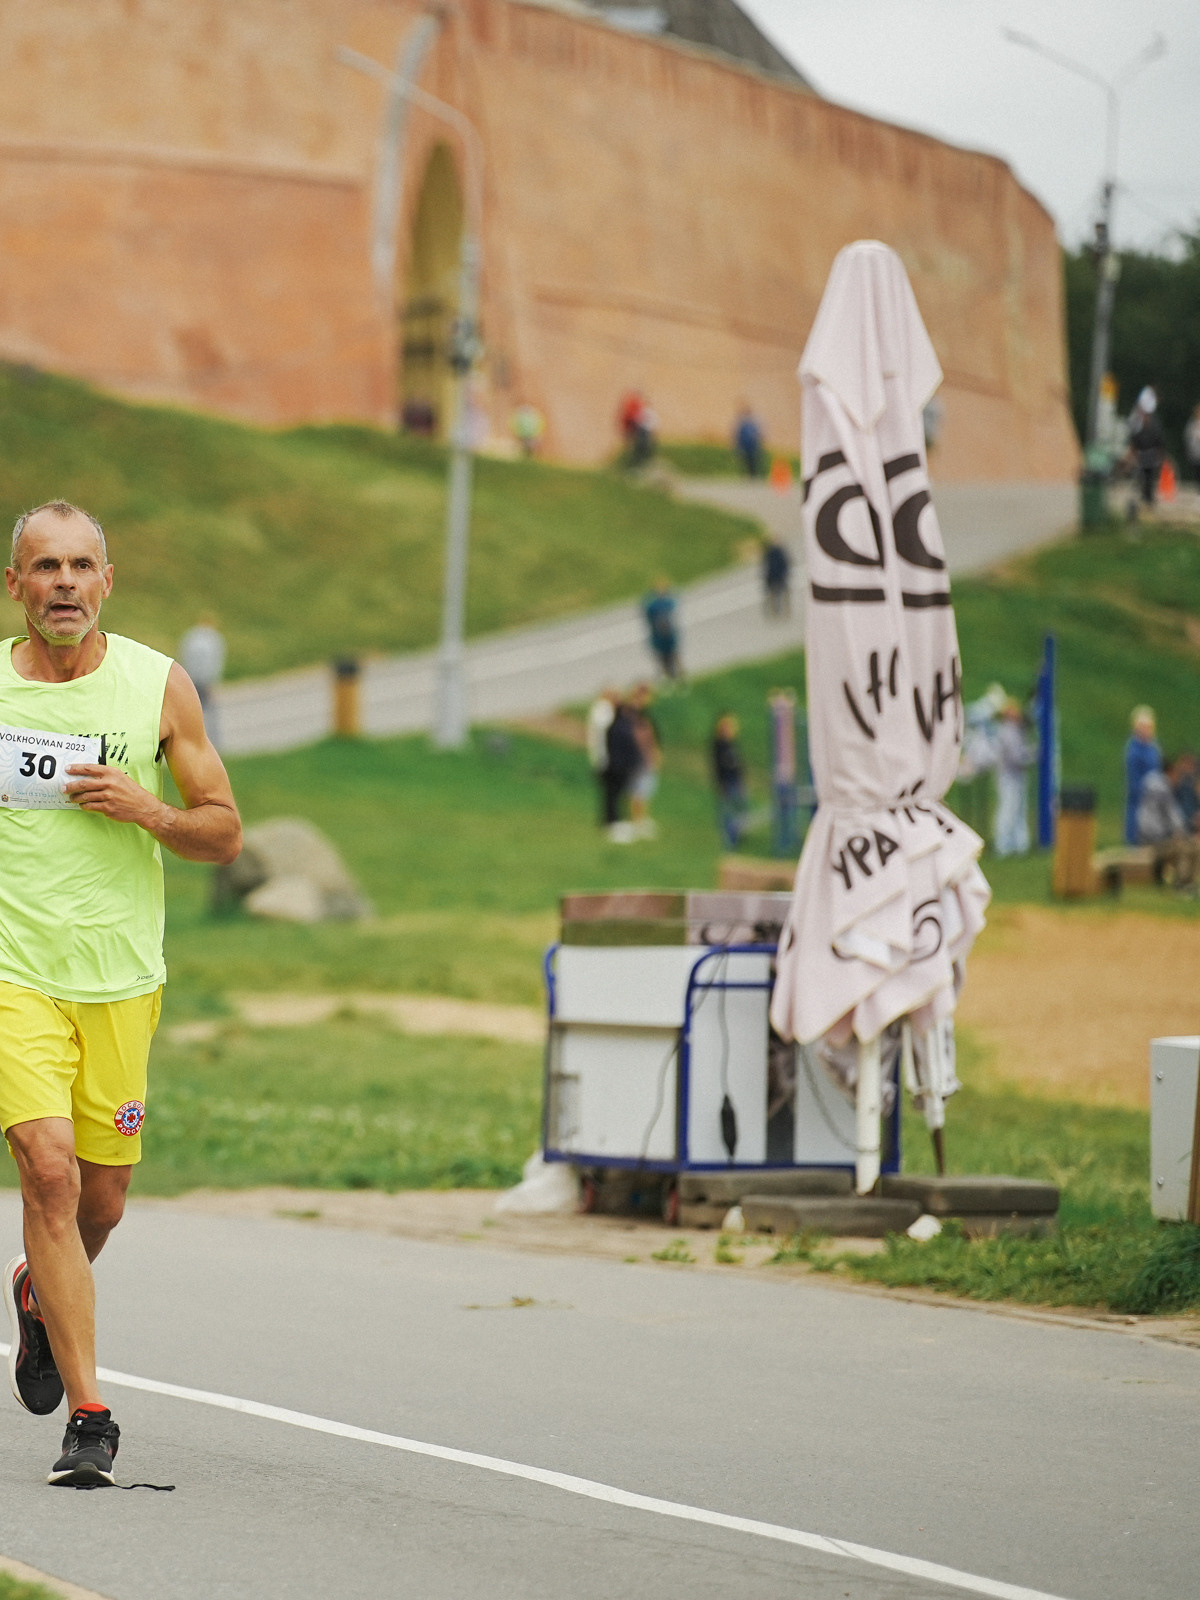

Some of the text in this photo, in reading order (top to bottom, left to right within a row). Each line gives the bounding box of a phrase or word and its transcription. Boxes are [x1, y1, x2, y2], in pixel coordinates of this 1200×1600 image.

[0, 732, 86, 752] VOLKHOVMAN 2023
[19, 752, 57, 780] 30
